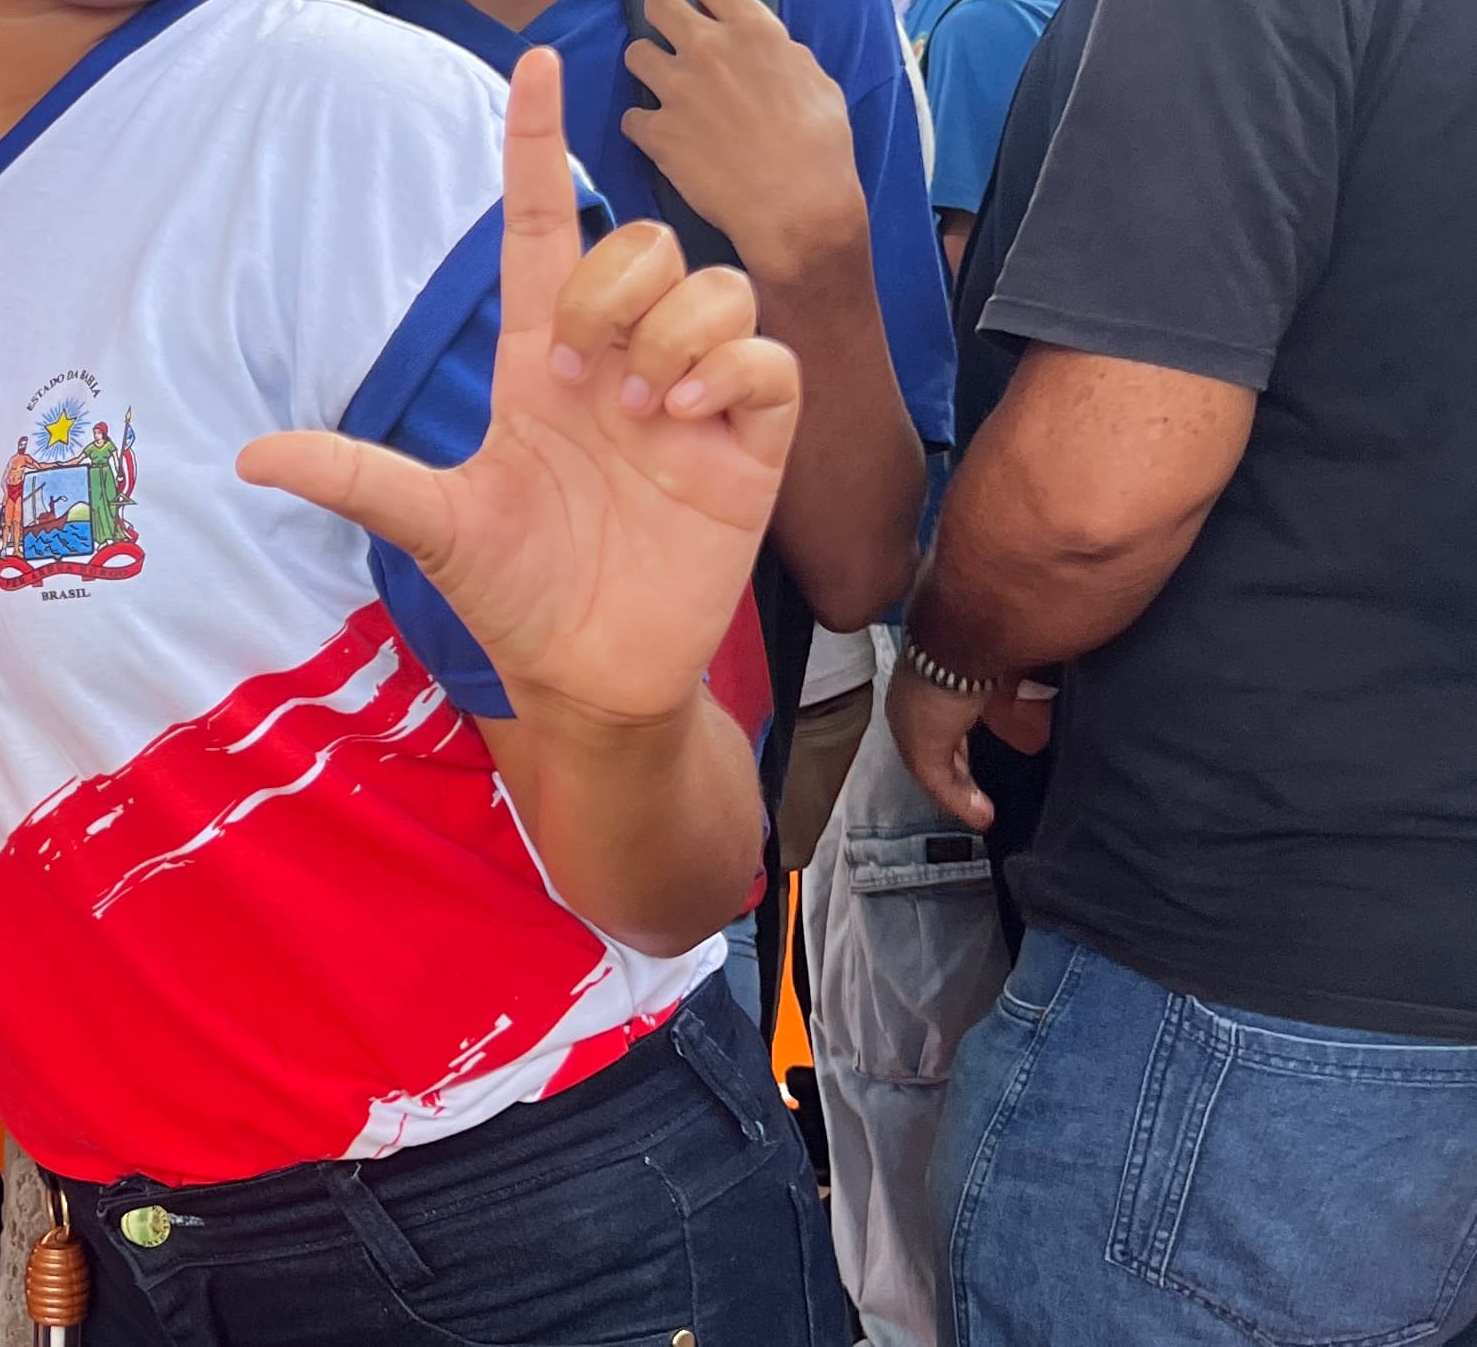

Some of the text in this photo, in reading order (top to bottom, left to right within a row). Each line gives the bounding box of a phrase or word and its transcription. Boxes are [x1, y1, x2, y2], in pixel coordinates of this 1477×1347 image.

[26, 368, 101, 411] ESTADO DA BAHIA
[41, 588, 91, 601] BRASIL
